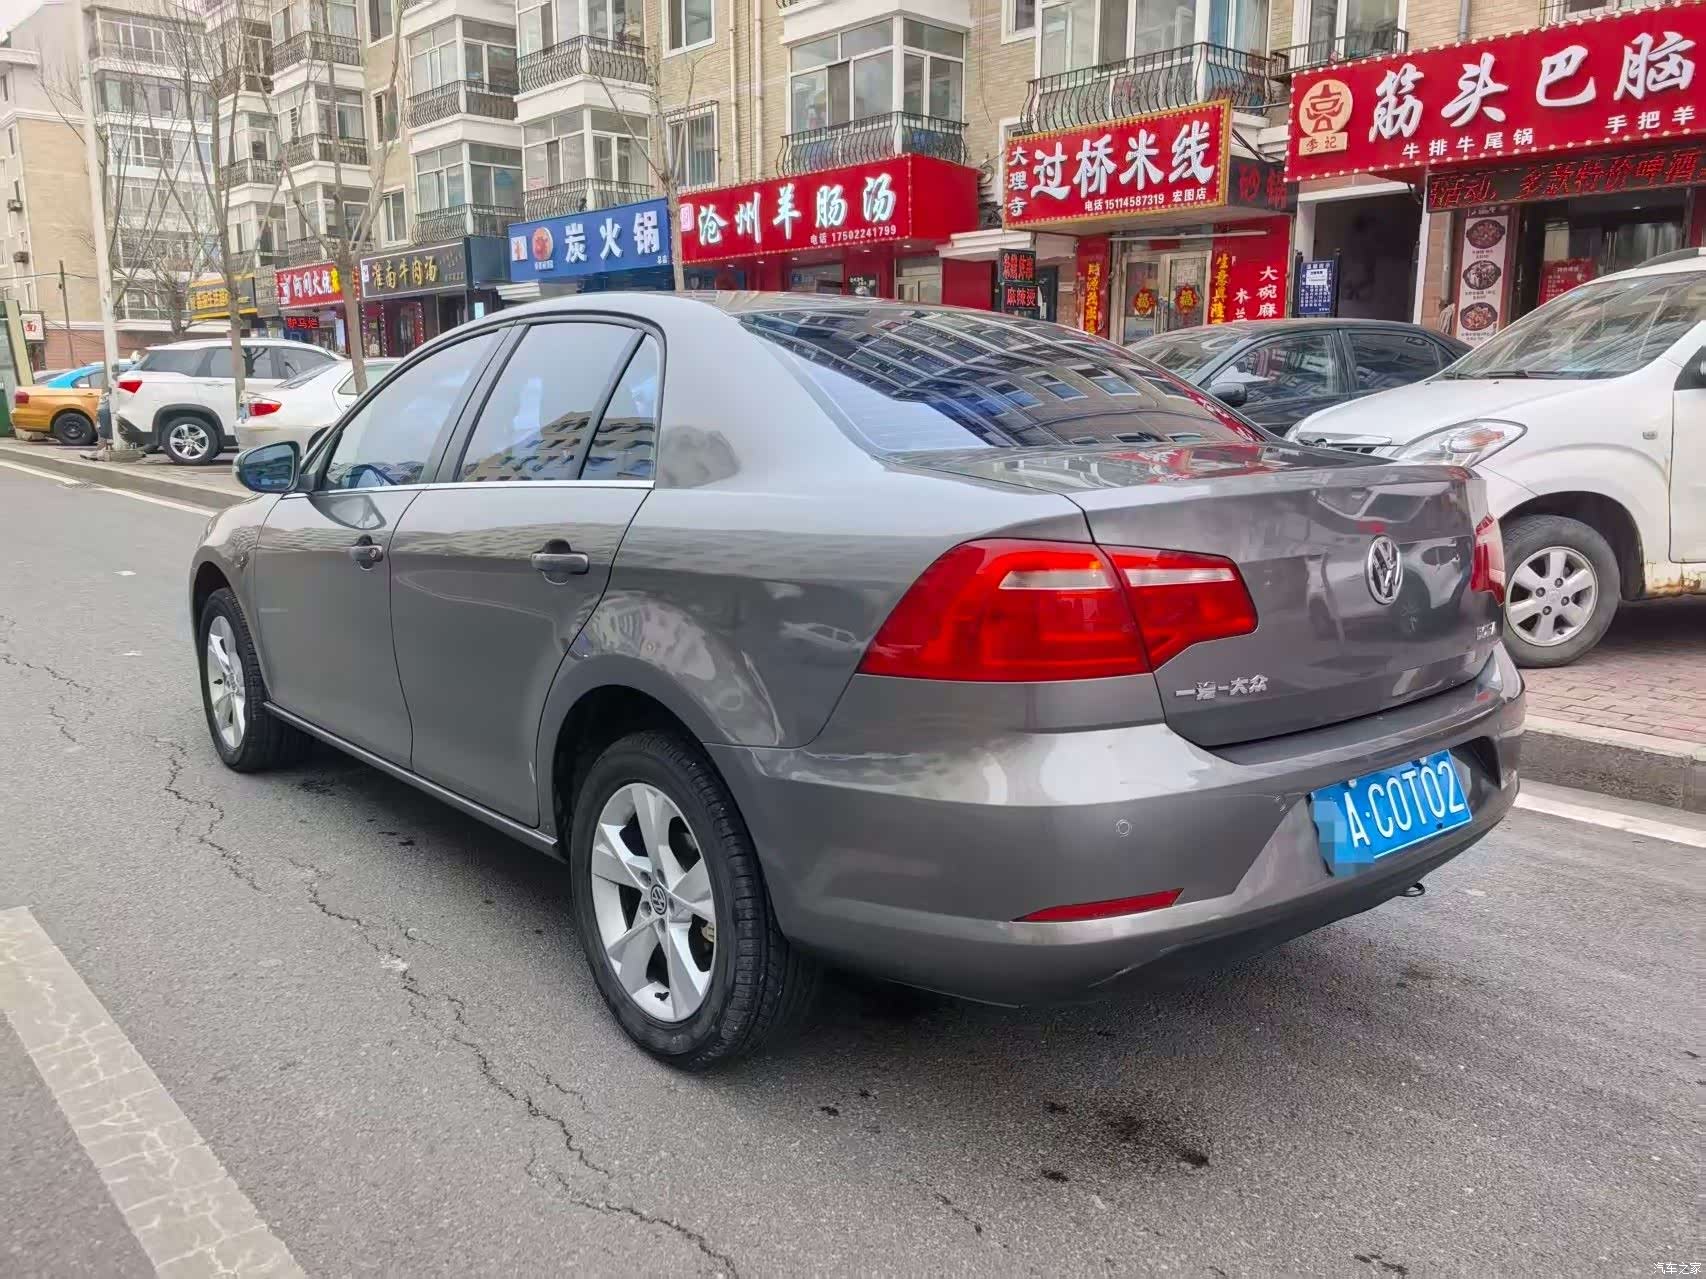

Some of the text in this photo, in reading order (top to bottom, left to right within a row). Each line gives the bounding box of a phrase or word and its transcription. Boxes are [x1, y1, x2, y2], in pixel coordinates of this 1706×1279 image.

[1369, 31, 1697, 143] 筋头巴脑
[1306, 135, 1337, 152] 李记
[1402, 127, 1533, 159] 牛排牛尾锅
[1605, 106, 1695, 134] 手把羊
[1009, 146, 1029, 217] 大理寺
[1031, 120, 1215, 200] 过桥米线
[1518, 153, 1706, 200] 多款特价啤酒
[698, 173, 896, 245] 沧州羊肠汤
[1085, 187, 1207, 211] 电话 15114587319 宏图店
[565, 211, 660, 263] 炭火锅
[810, 225, 897, 245] 电话 17502241799
[372, 255, 438, 290] 淮南牛肉汤
[1256, 266, 1279, 317] 大碗麻
[1007, 287, 1036, 306] 麻辣烫
[1343, 760, 1465, 848] A·C0T02
